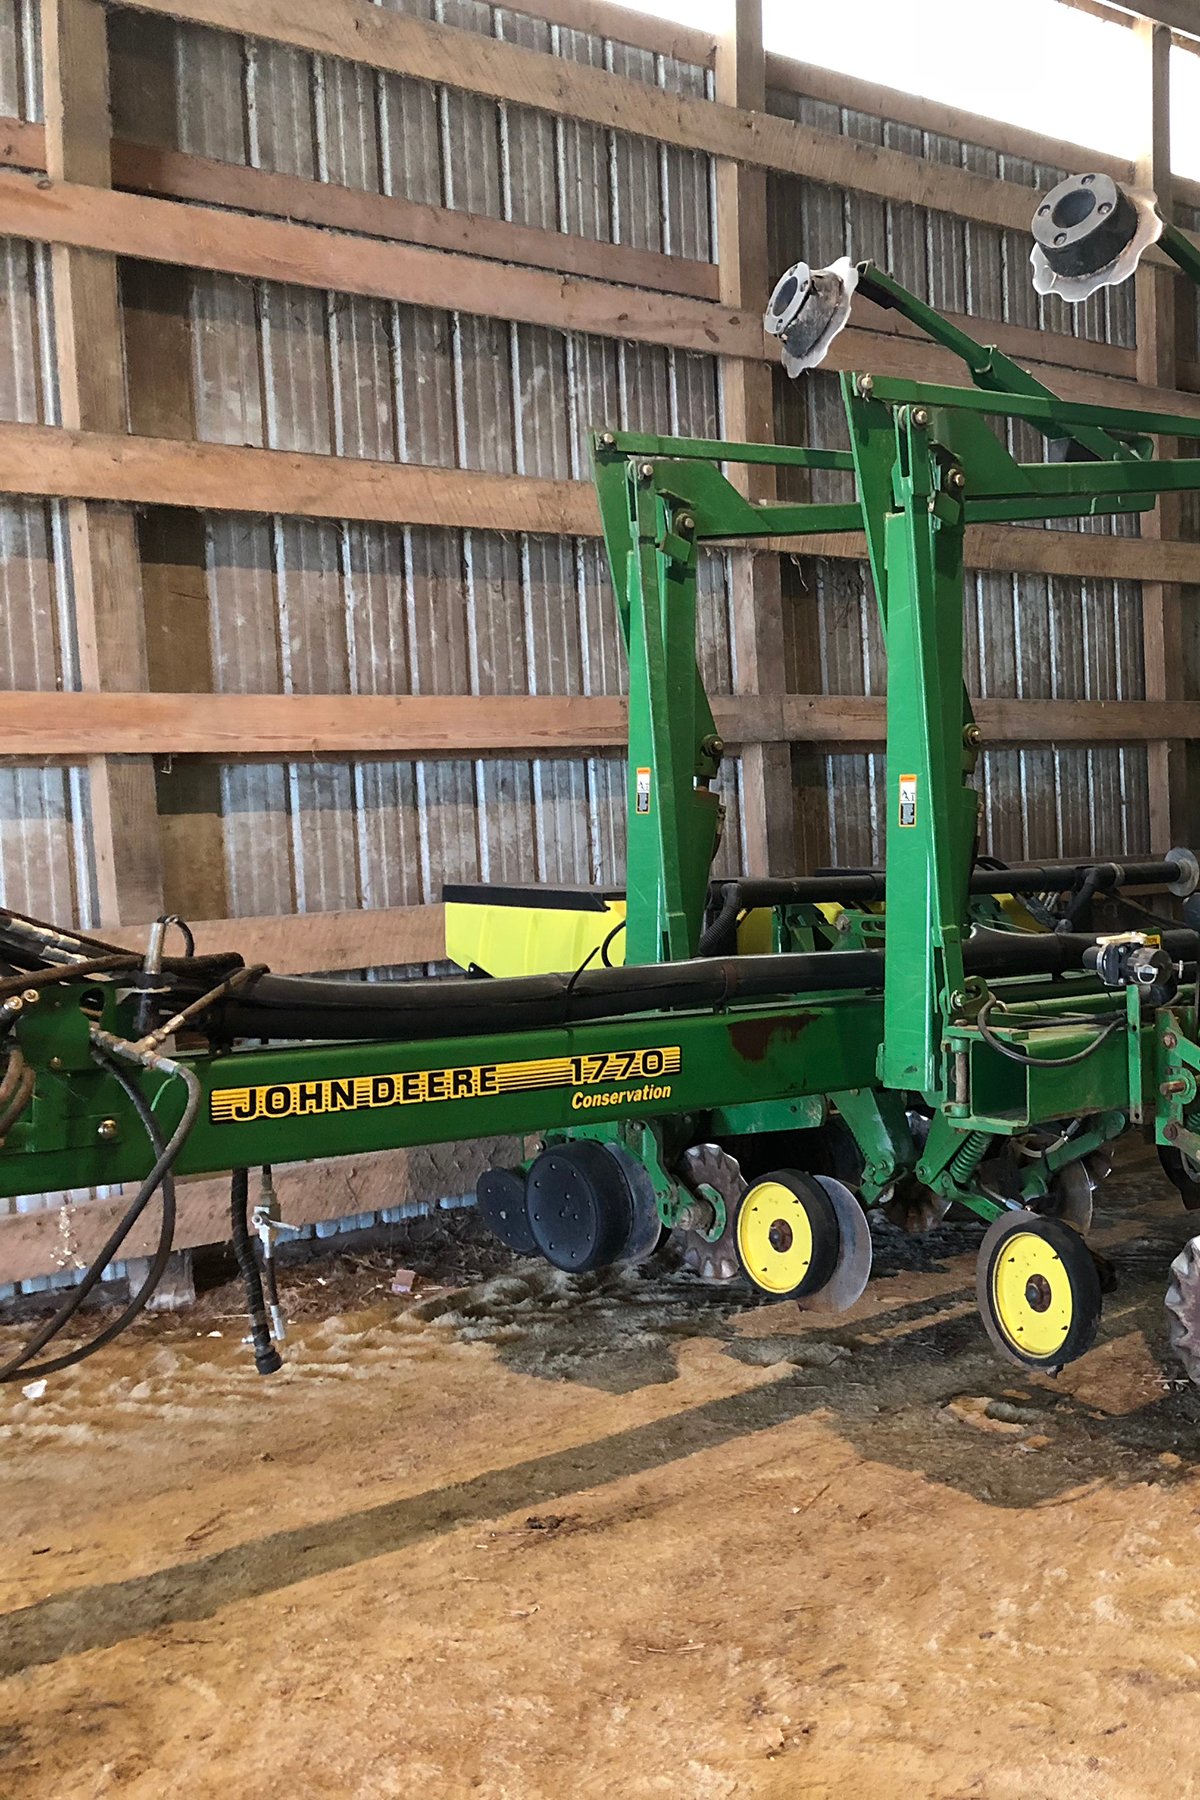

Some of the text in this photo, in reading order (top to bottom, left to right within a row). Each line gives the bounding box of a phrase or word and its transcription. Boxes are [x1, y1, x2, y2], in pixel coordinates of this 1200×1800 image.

[233, 1049, 664, 1120] JOHN DEERE 1770
[572, 1084, 672, 1109] Conservation
